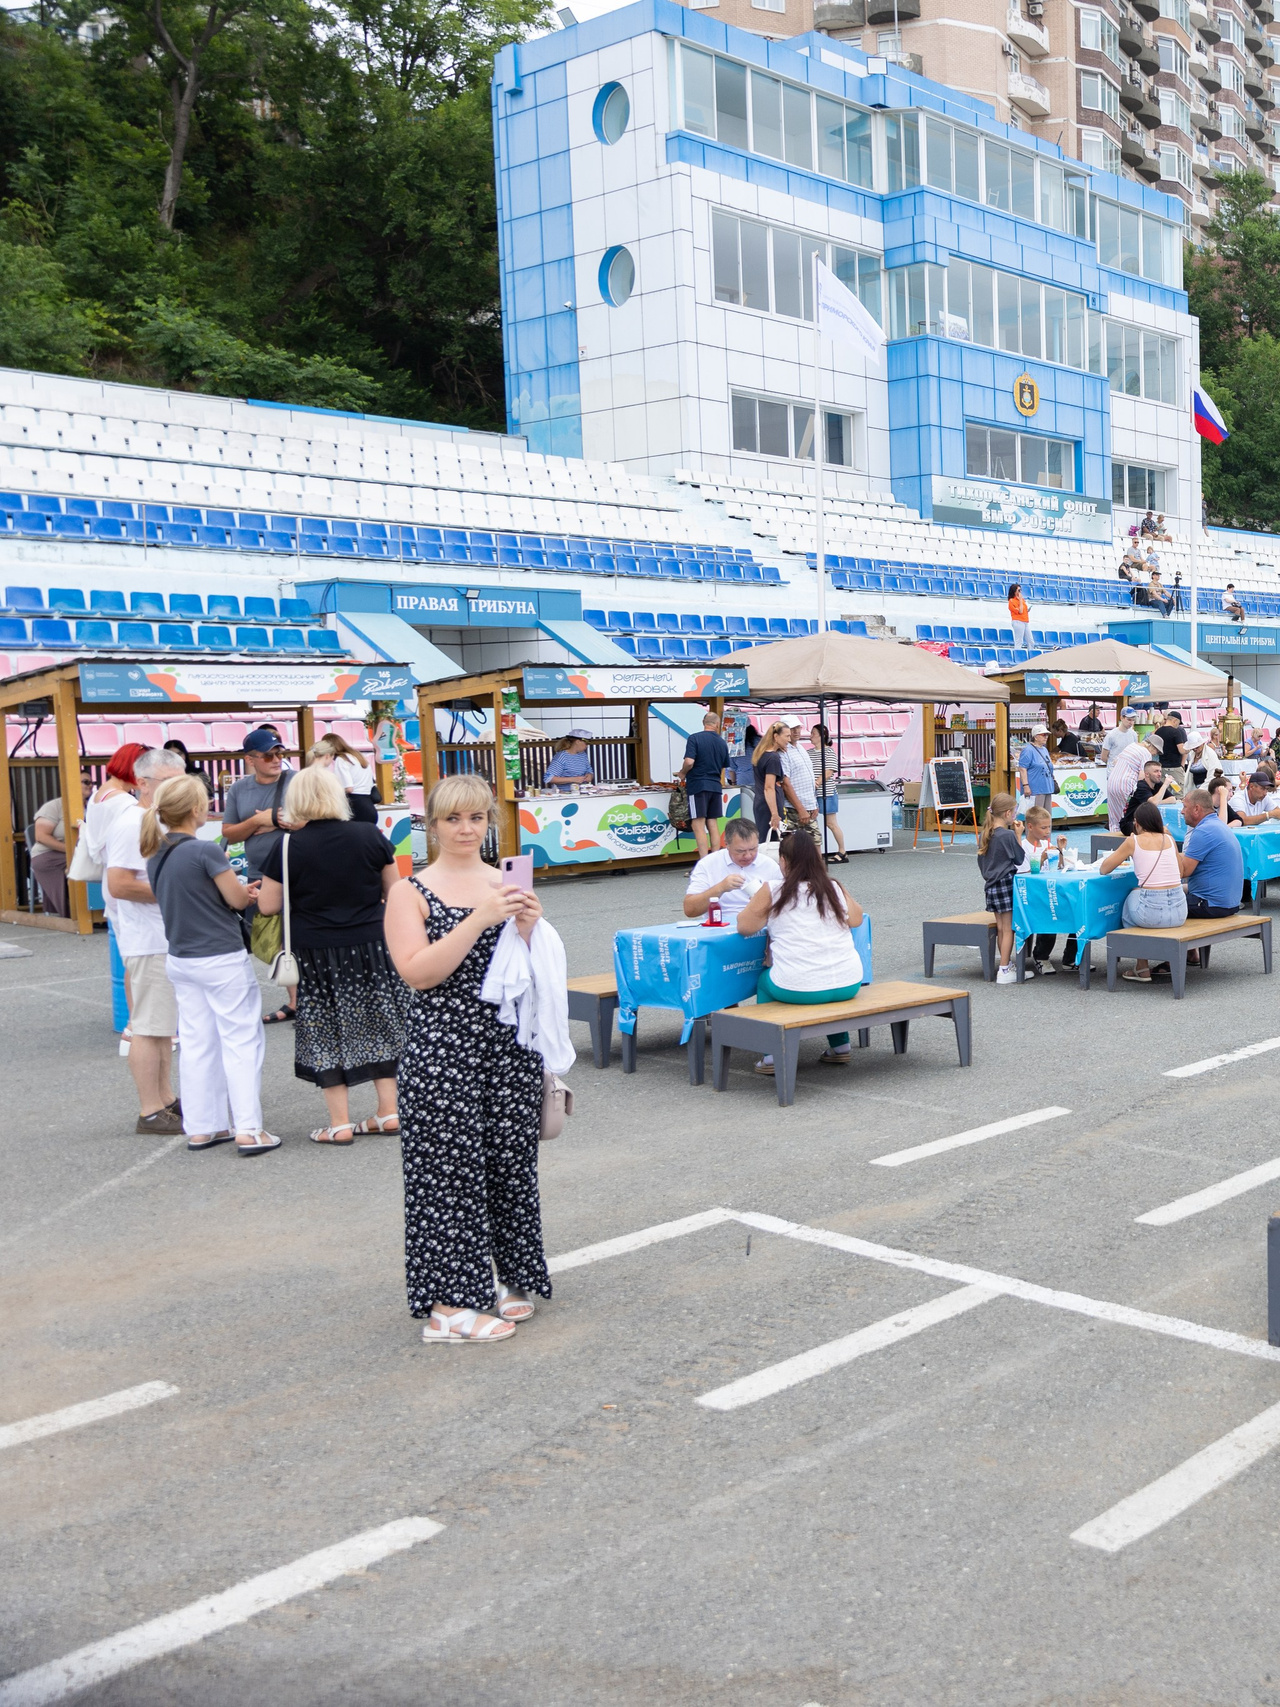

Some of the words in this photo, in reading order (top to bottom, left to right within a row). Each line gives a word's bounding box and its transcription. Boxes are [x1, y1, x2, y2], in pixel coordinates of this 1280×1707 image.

[948, 485, 1060, 512] ТИХООКЕАНСКИЙ
[1063, 499, 1098, 518] ФЛОТ
[981, 508, 1017, 525] ВМФ
[1021, 513, 1073, 533] РОССИИ
[396, 595, 459, 612] ПРАВАЯ
[468, 598, 537, 615] ТРИБУНА
[1205, 634, 1249, 646] ЦЕНТРАЛЬНАЯ
[1249, 636, 1276, 647] ТРИБУНА
[610, 685, 677, 695] ОСТРОВОК
[632, 939, 641, 981] PRIMORYE
[659, 941, 670, 982] PRIMORYE
[663, 941, 671, 964] VISIT
